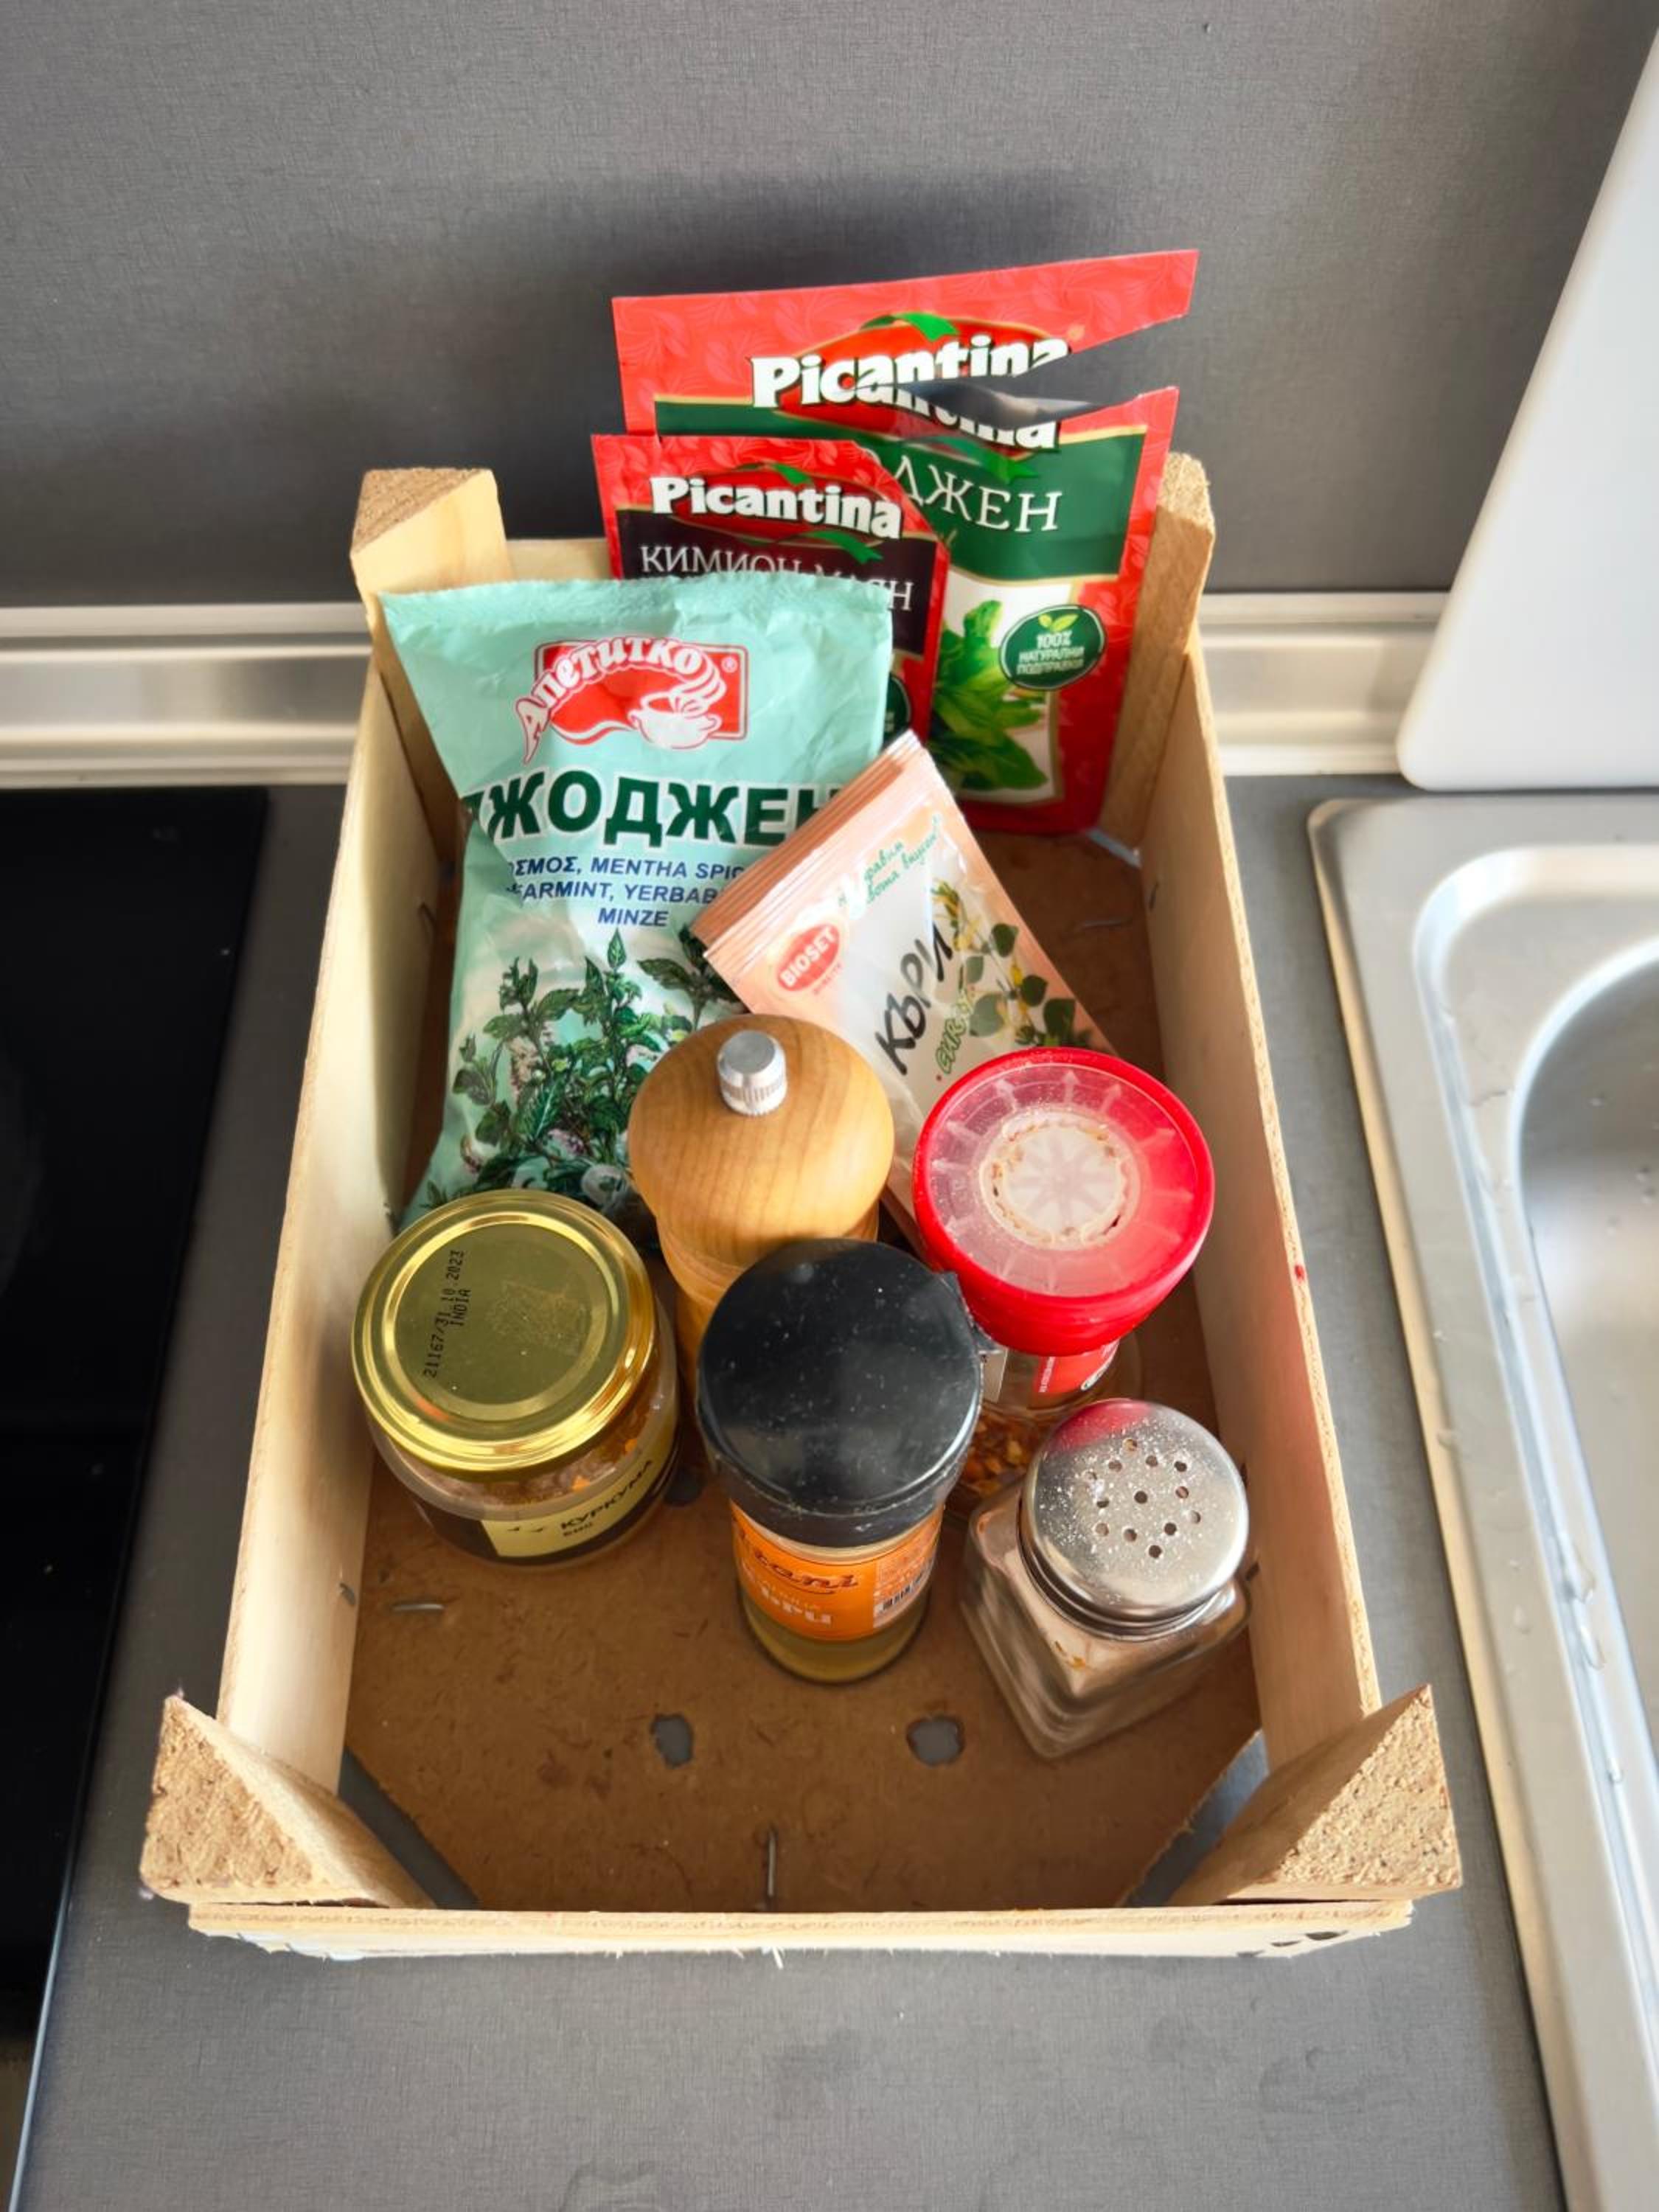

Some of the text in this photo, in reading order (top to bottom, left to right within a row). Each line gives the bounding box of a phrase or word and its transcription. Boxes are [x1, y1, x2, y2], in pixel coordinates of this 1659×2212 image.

[867, 448, 1062, 532] ДЖЕН
[650, 476, 901, 538] Picantina
[1037, 629, 1072, 648] 100%
[510, 857, 745, 880] ΣΜΟΣ, MENTHA SPIC
[625, 885, 720, 904] YERBAB
[598, 908, 669, 927] MINZE
[779, 926, 835, 988] BIOSET
[448, 1289, 472, 1326] INDIA
